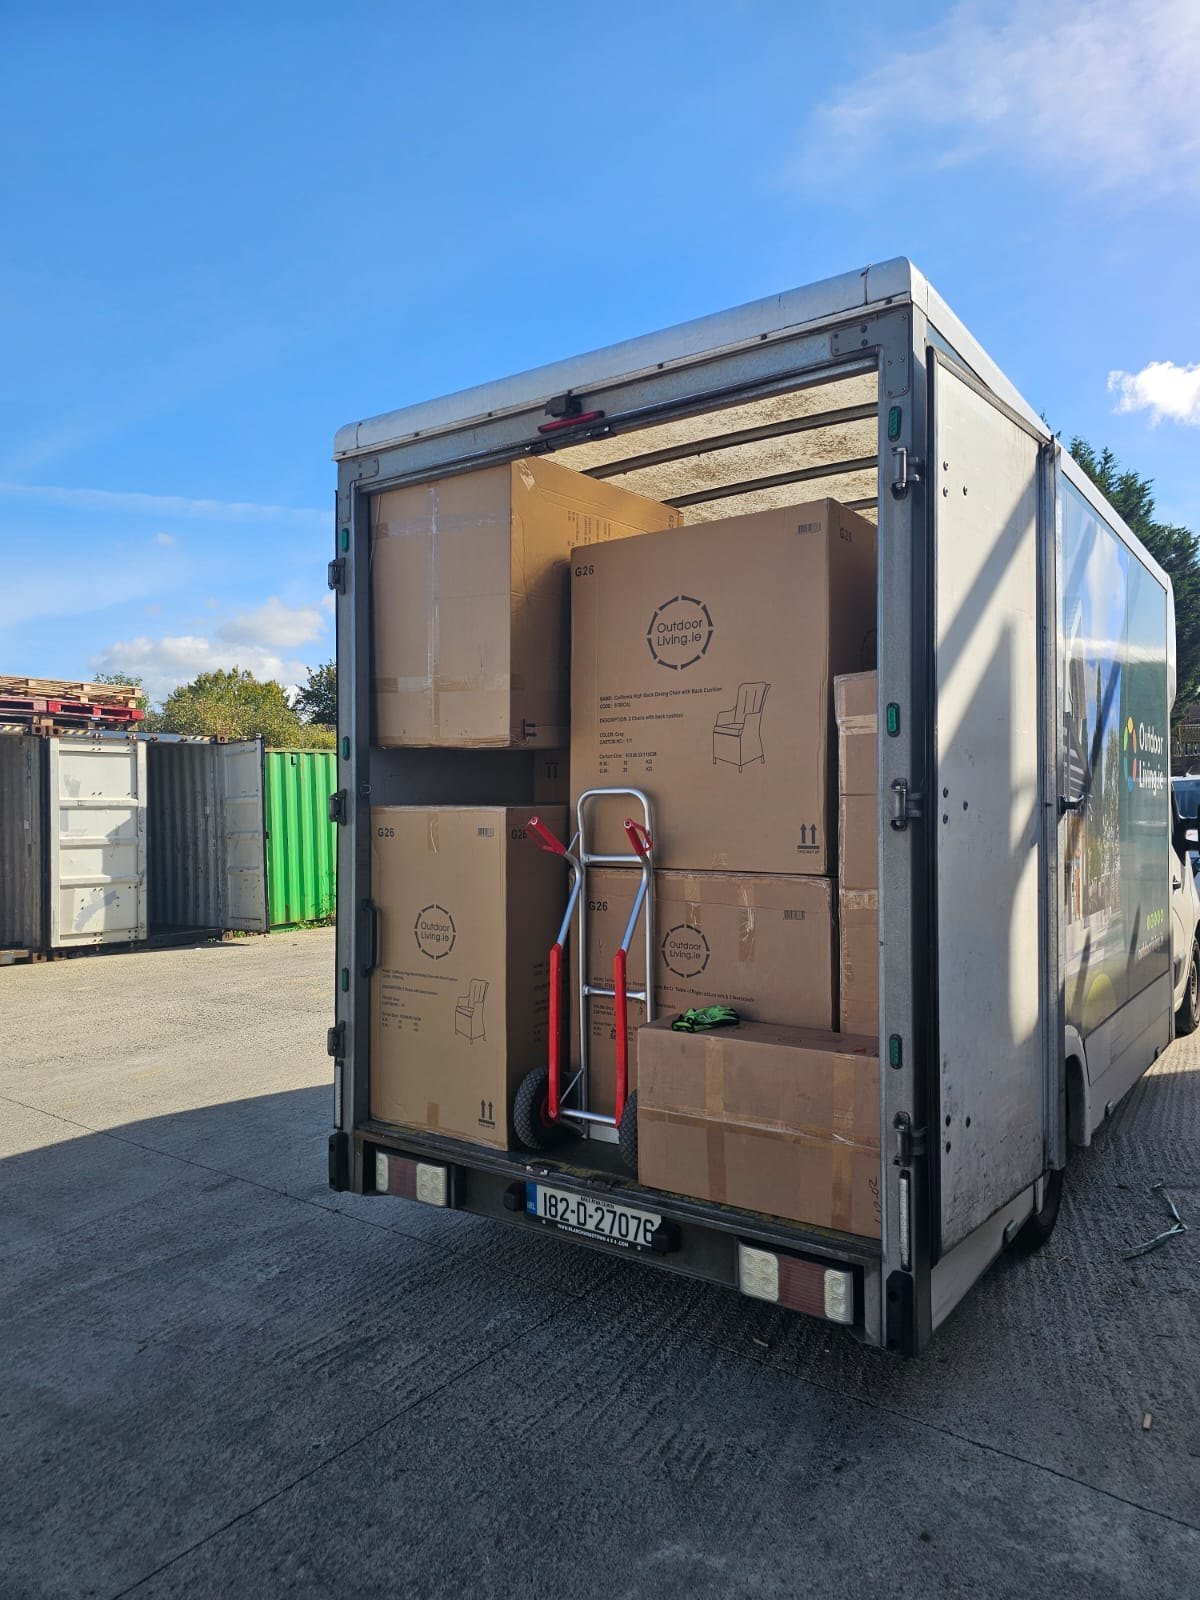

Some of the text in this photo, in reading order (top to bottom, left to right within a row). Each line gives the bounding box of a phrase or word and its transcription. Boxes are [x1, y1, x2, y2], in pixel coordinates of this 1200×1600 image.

[575, 565, 594, 577] G26
[657, 620, 702, 633] Outdoor
[657, 632, 702, 647] Living.ie
[1139, 721, 1164, 756] Outdoor
[377, 827, 395, 838] G26
[511, 828, 528, 840] G26
[588, 901, 608, 912] G26
[421, 921, 450, 931] Outdoor
[669, 940, 701, 950] Outdoor
[669, 950, 701, 960] Living.ie
[543, 1192, 655, 1244] 182-D-27076
